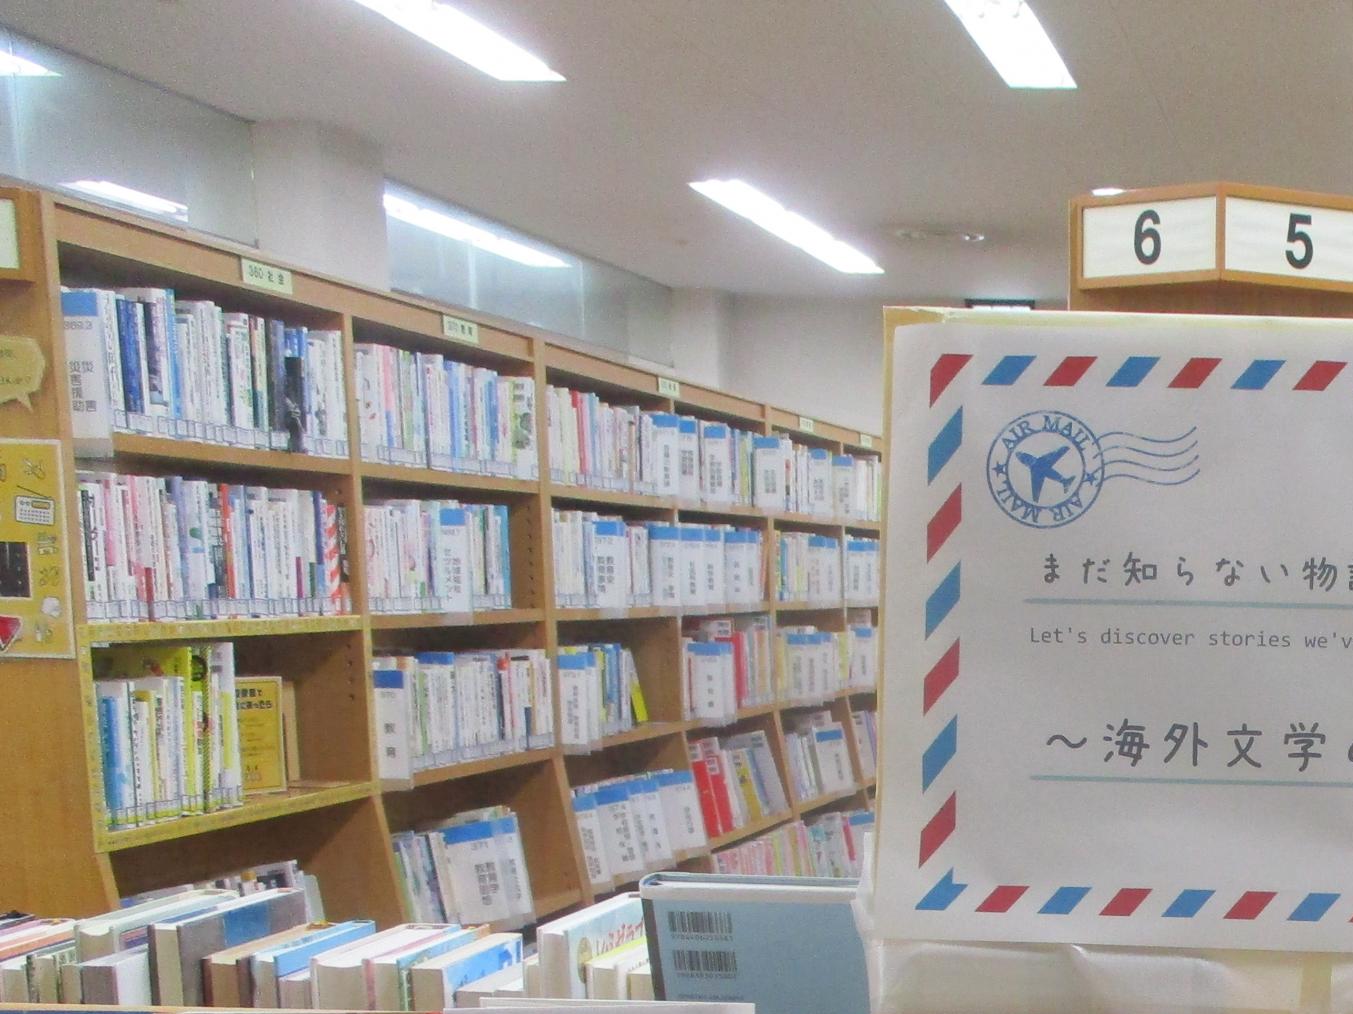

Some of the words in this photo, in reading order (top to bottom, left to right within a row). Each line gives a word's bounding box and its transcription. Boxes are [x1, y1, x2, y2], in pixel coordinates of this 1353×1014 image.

[1132, 210, 1162, 266] 6
[1284, 214, 1314, 270] 5
[1001, 420, 1037, 450] AIR
[1042, 414, 1087, 452] MAIL
[996, 479, 1042, 524] MAIL
[1049, 491, 1084, 522] AIR
[1029, 626, 1088, 647] Let's
[1099, 627, 1195, 648] discover
[1207, 629, 1292, 650] stories
